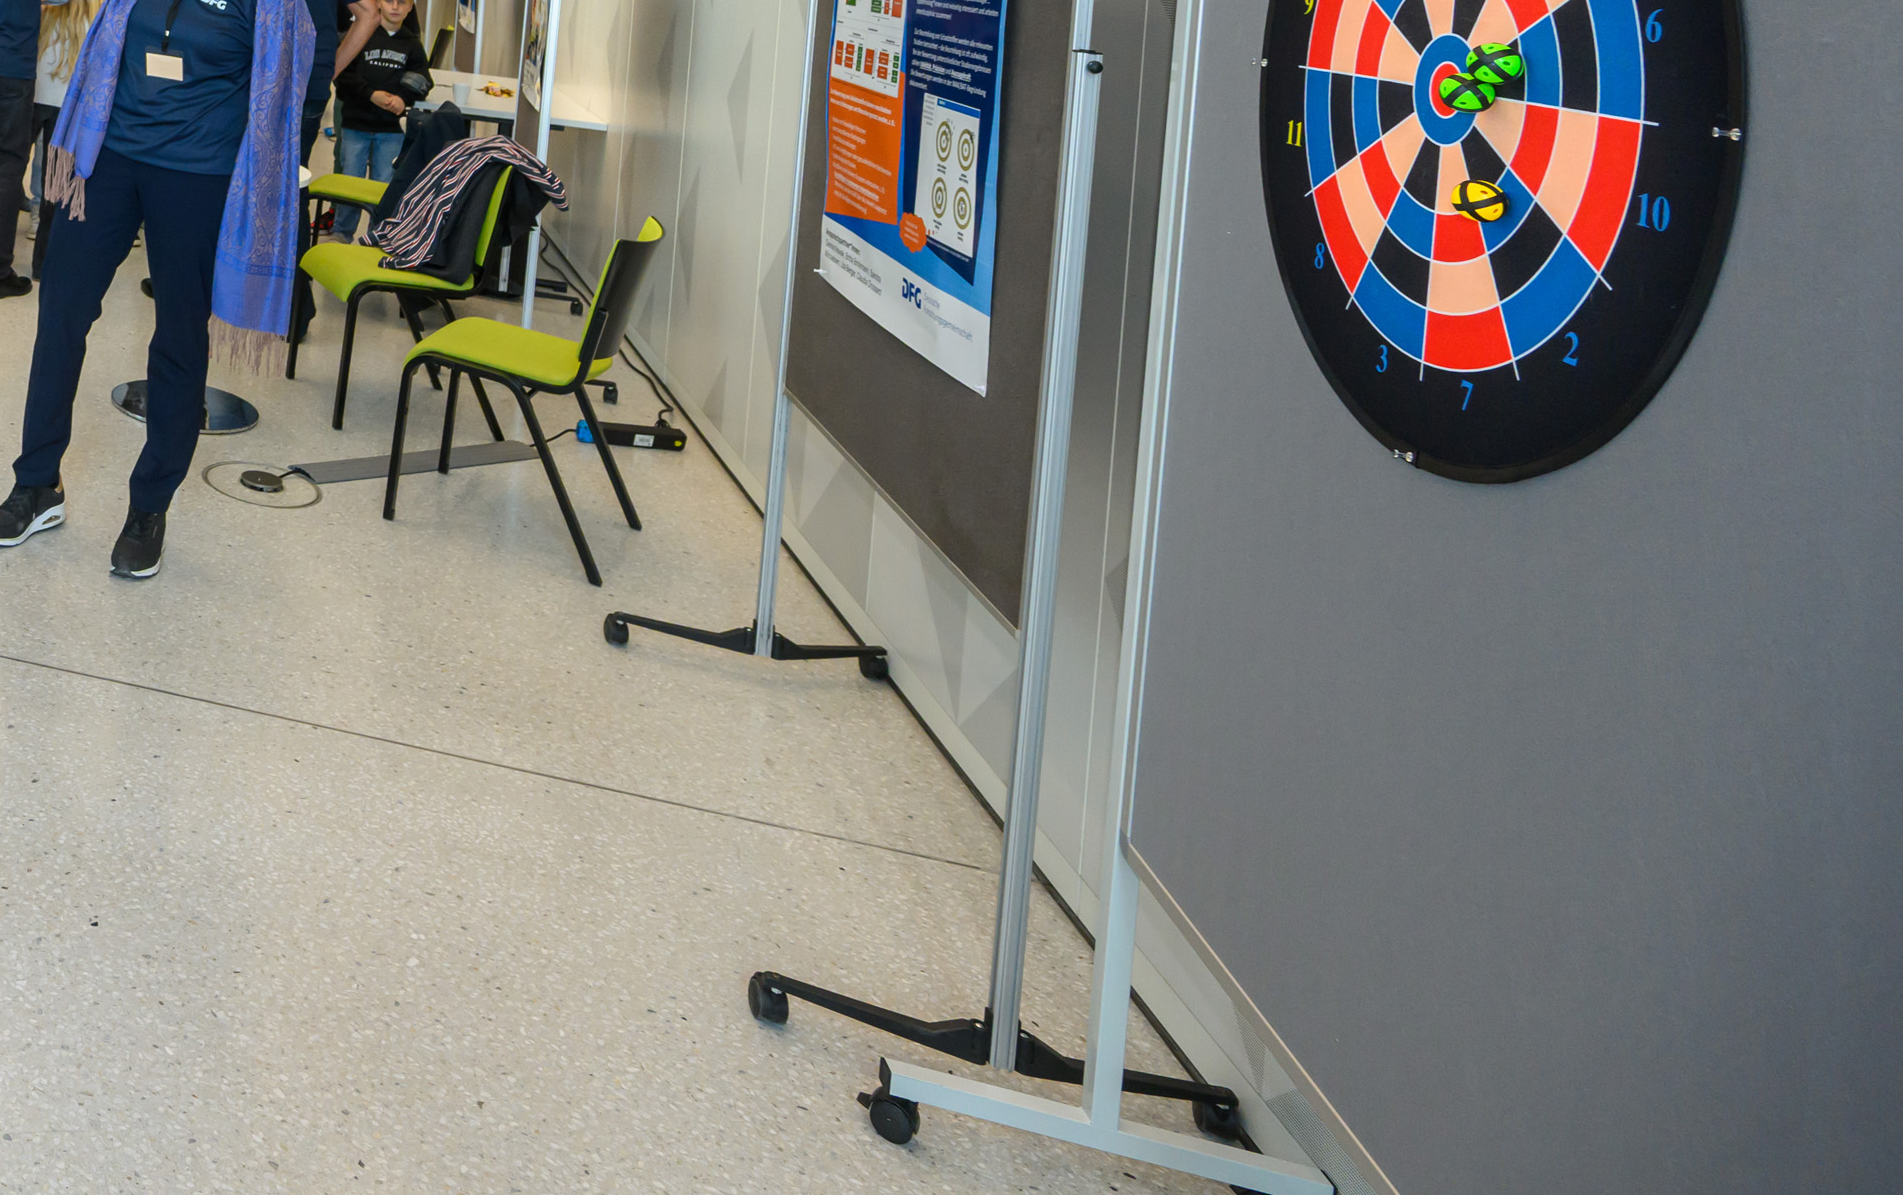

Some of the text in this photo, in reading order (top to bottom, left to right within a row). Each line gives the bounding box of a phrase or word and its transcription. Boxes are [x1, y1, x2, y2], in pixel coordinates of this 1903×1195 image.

[1645, 8, 1664, 43] 6
[1286, 119, 1303, 147] 11
[1636, 192, 1671, 233] 10
[1314, 242, 1326, 269] 8
[902, 277, 922, 310] DFG
[1375, 344, 1389, 373] 3
[1562, 331, 1580, 366] 2
[1460, 379, 1474, 411] 7
